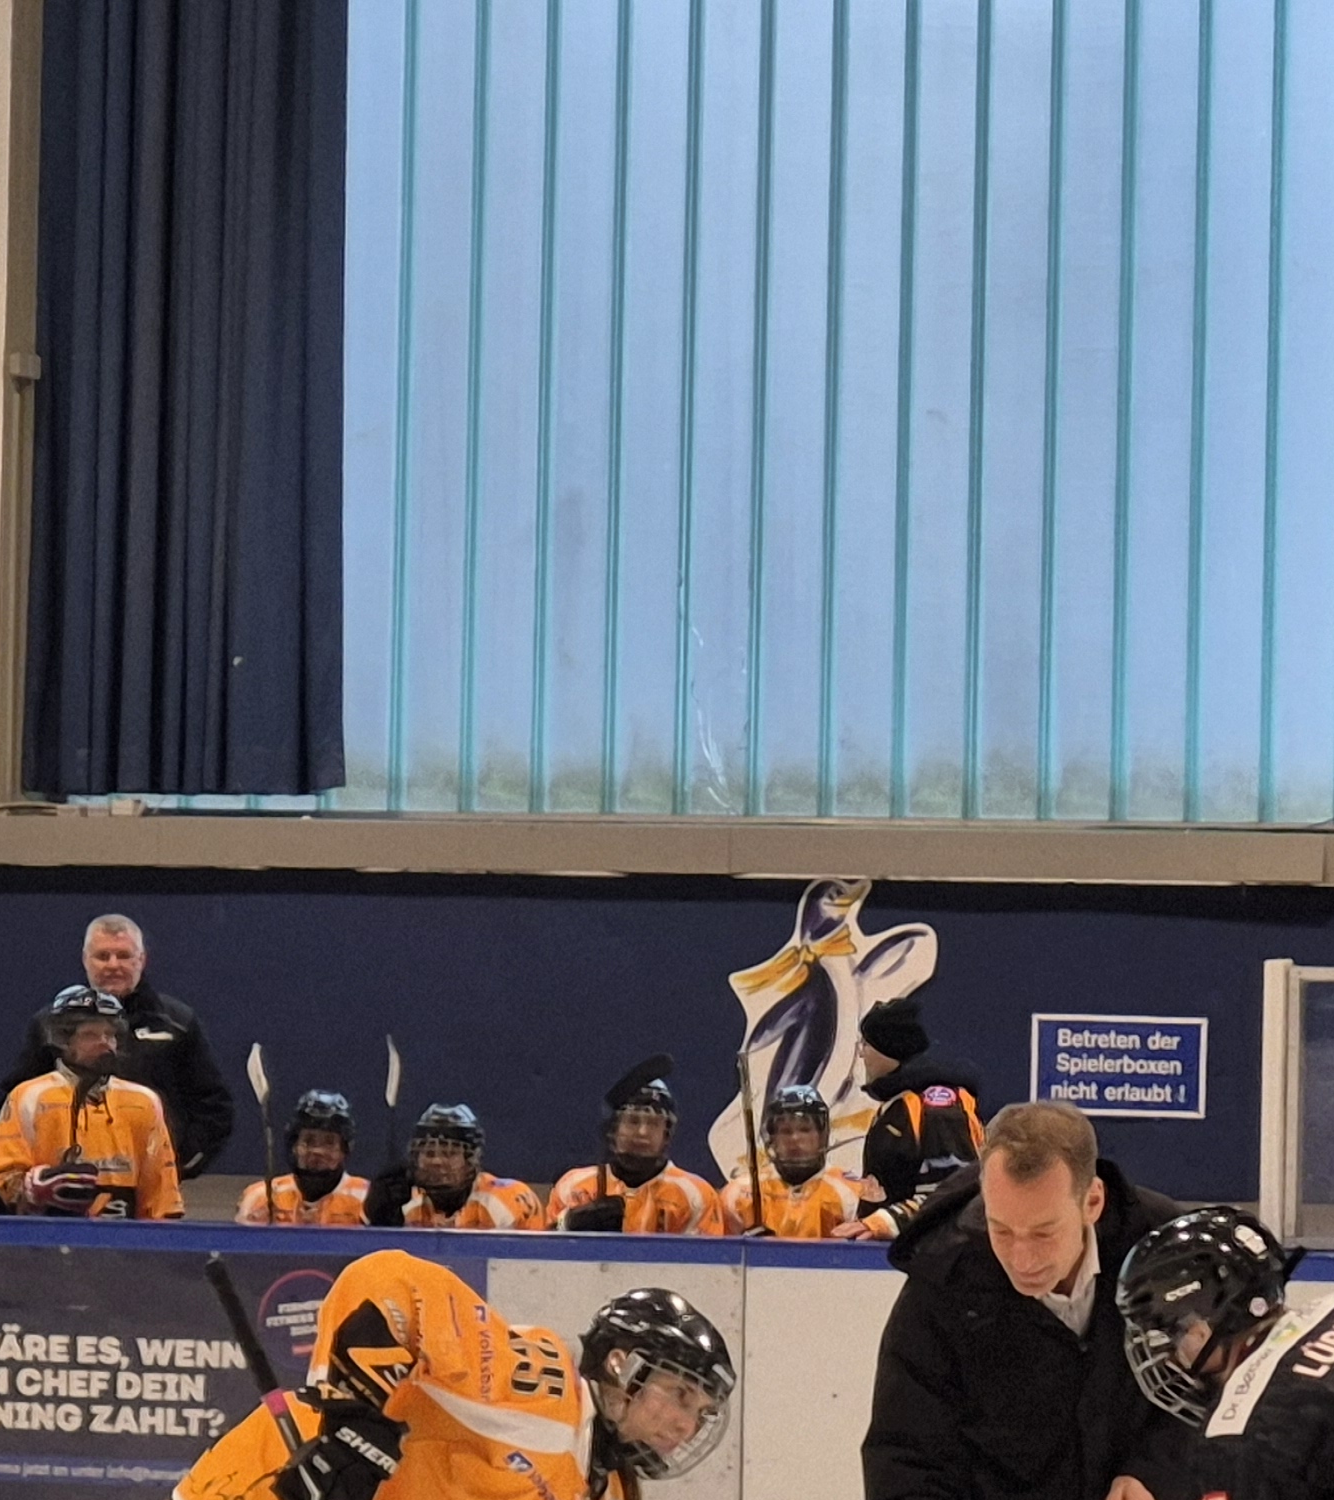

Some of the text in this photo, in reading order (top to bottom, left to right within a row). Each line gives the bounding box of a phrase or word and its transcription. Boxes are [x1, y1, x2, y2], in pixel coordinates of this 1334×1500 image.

[1057, 1028, 1182, 1051] Betreten der
[1056, 1053, 1182, 1076] Spielerboxen
[1051, 1080, 1098, 1101] nicht
[1104, 1084, 1172, 1103] erlaubt
[76, 1336, 129, 1370] ES,
[137, 1338, 248, 1371] WENN
[16, 1369, 112, 1399] CHEF
[116, 1372, 206, 1403] DEIN
[89, 1405, 226, 1438] ZAHLT?
